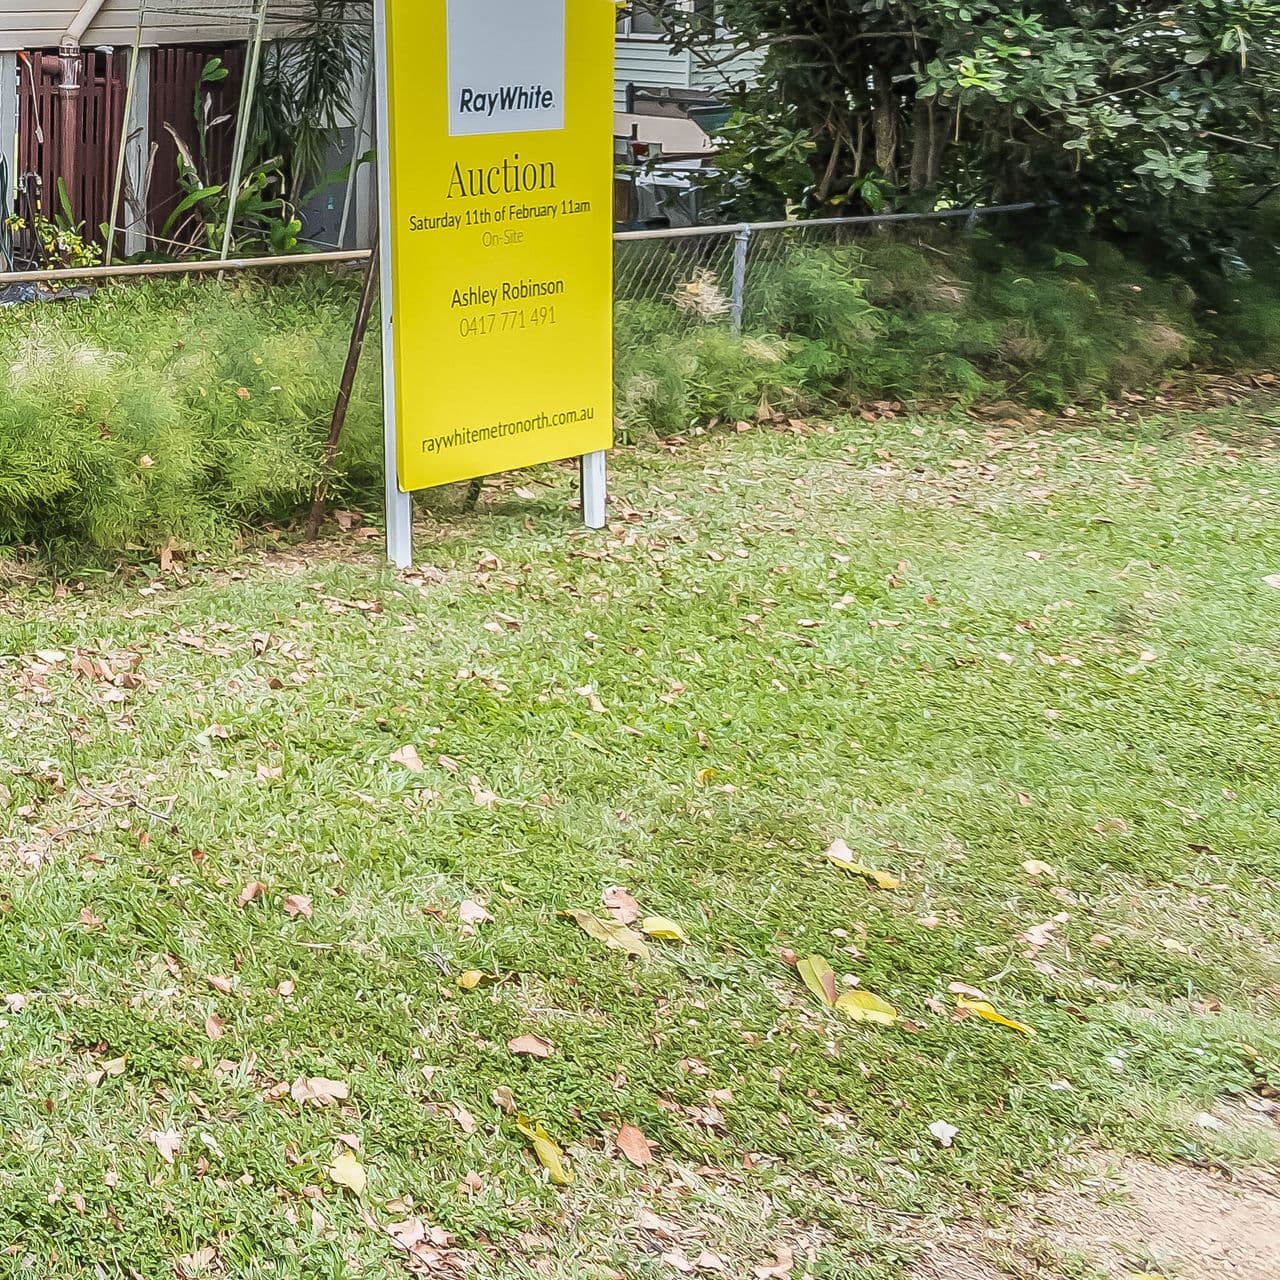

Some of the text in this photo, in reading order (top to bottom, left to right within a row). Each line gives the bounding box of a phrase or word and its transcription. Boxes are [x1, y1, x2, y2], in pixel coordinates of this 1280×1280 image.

[446, 153, 556, 199] Auction
[409, 200, 591, 232] Saturday 11th of February 11am
[482, 229, 524, 247] On-Site
[451, 278, 564, 308] Ashley Robinson
[459, 305, 556, 337] 0417 771 491
[422, 407, 594, 454] raywhitemetronorth.com.au
